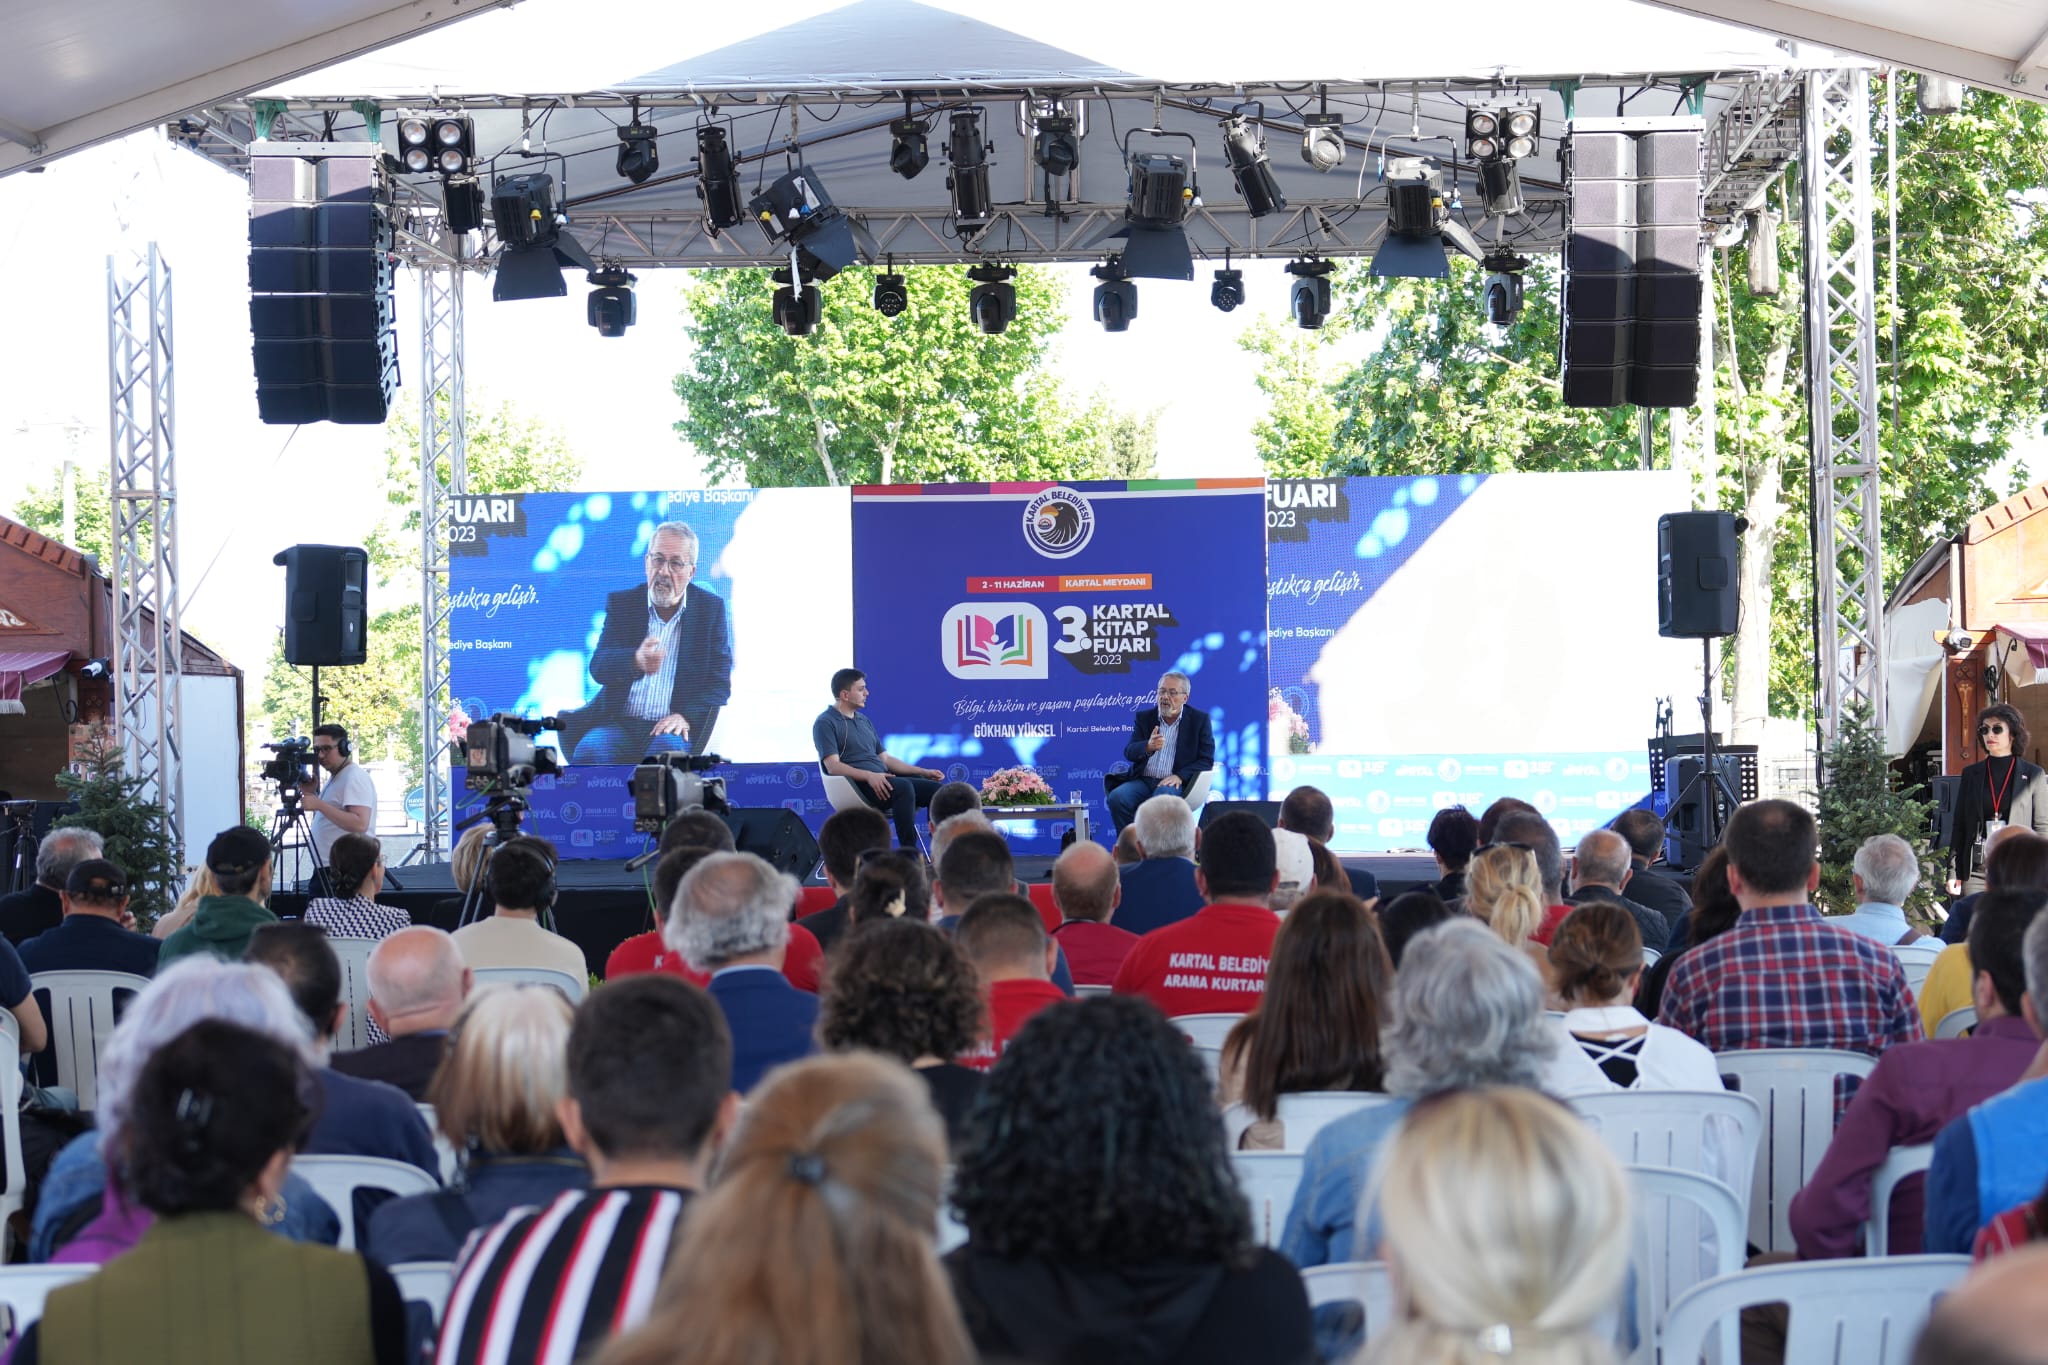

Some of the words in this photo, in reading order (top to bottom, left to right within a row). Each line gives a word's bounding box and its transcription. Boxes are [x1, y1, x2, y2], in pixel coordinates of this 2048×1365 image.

[1026, 494, 1050, 522] KARTAL
[1051, 491, 1092, 521] BELEDİYESİ
[1003, 578, 1044, 589] HAZİRAN
[1065, 579, 1101, 588] KARTAL
[1103, 578, 1146, 586] MEYDANI
[1093, 603, 1169, 620] KARTAL
[1296, 627, 1335, 638] Başkanı
[475, 639, 513, 651] Başkanı
[1093, 637, 1151, 653] FUARI
[1093, 654, 1122, 665] 2023
[987, 699, 1025, 713] birikim
[1026, 701, 1038, 711] ve
[1036, 700, 1072, 716] yaşam
[1073, 692, 1133, 713] paylaştıkça
[974, 722, 1016, 738] GÖKHAN
[1017, 721, 1056, 738] YÜKSEL
[1066, 725, 1089, 733] Kartal
[1091, 724, 1121, 734] Belediye
[1169, 953, 1215, 970] KARTAL
[1219, 955, 1270, 973] BELEDİY
[1163, 973, 1208, 989] ARAMA
[1211, 976, 1265, 992] KURTAR
